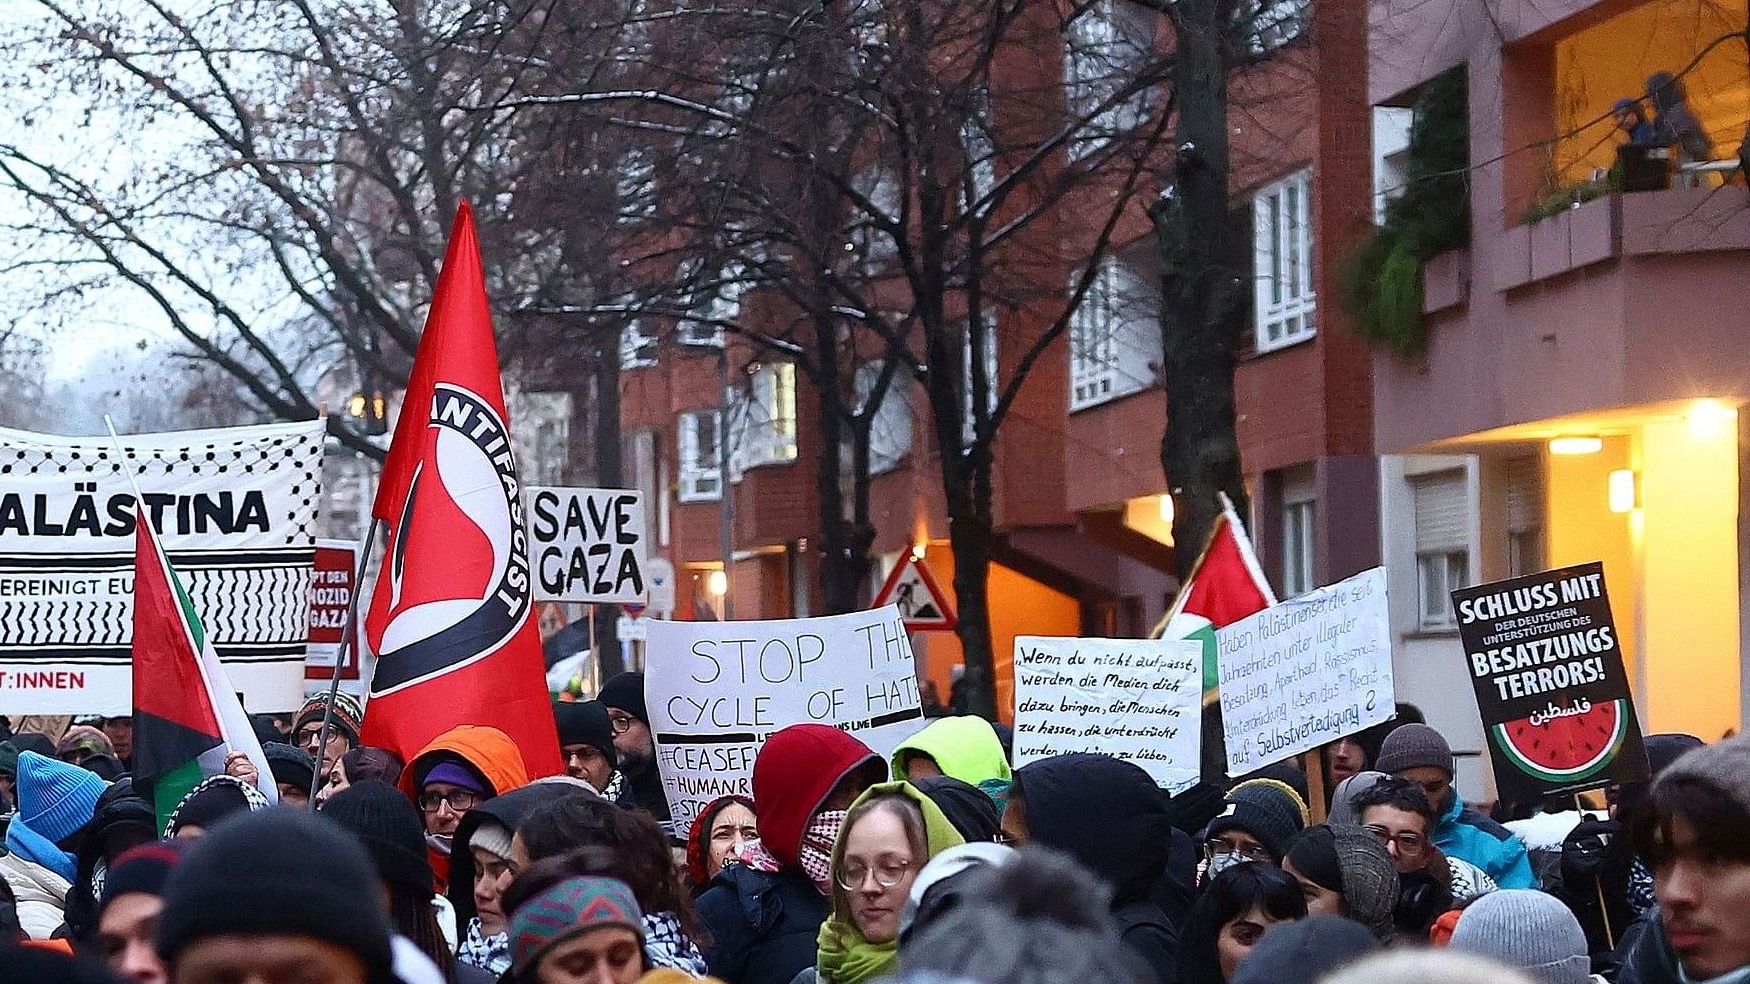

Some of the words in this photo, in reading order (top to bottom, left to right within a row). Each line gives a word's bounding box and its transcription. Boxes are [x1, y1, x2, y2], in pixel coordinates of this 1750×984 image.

[533, 491, 639, 545] SAVE
[539, 543, 643, 597] GAZA
[109, 578, 135, 595] EU
[1459, 582, 1558, 625] SCHLUSS
[1560, 573, 1601, 605] MIT
[1482, 619, 1572, 646] UNTERSTÜTZUNG
[1572, 615, 1592, 628] DES
[1495, 618, 1516, 633] DER
[1517, 607, 1578, 628] DEUTSCHEN
[1219, 630, 1253, 657] Haben
[1471, 626, 1615, 678] BESATZUNGS
[690, 633, 825, 684] STOP
[1067, 650, 1086, 666] du
[1093, 653, 1132, 667] nicht
[1220, 650, 1281, 685] Jahrzehnten
[1284, 636, 1312, 660] unter
[1021, 671, 1073, 686] werden
[1079, 672, 1097, 688] die
[1103, 673, 1148, 690] Medien
[1152, 677, 1180, 693] dich
[1493, 656, 1606, 701] TERRORS!
[667, 695, 775, 728] CYCLE
[806, 688, 845, 720] OF
[1019, 697, 1054, 713] dazu
[1059, 696, 1106, 717] bringen,
[1528, 696, 1592, 726] فلسطين
[1018, 722, 1035, 733] zu
[1084, 724, 1101, 737] die
[1104, 724, 1178, 740] unterdrückt
[660, 746, 758, 771] #CEASEF
[1118, 751, 1133, 760] zu
[1136, 747, 1173, 764] lieben,
[1232, 738, 1250, 765] auf
[665, 776, 750, 795] #HUMANR
